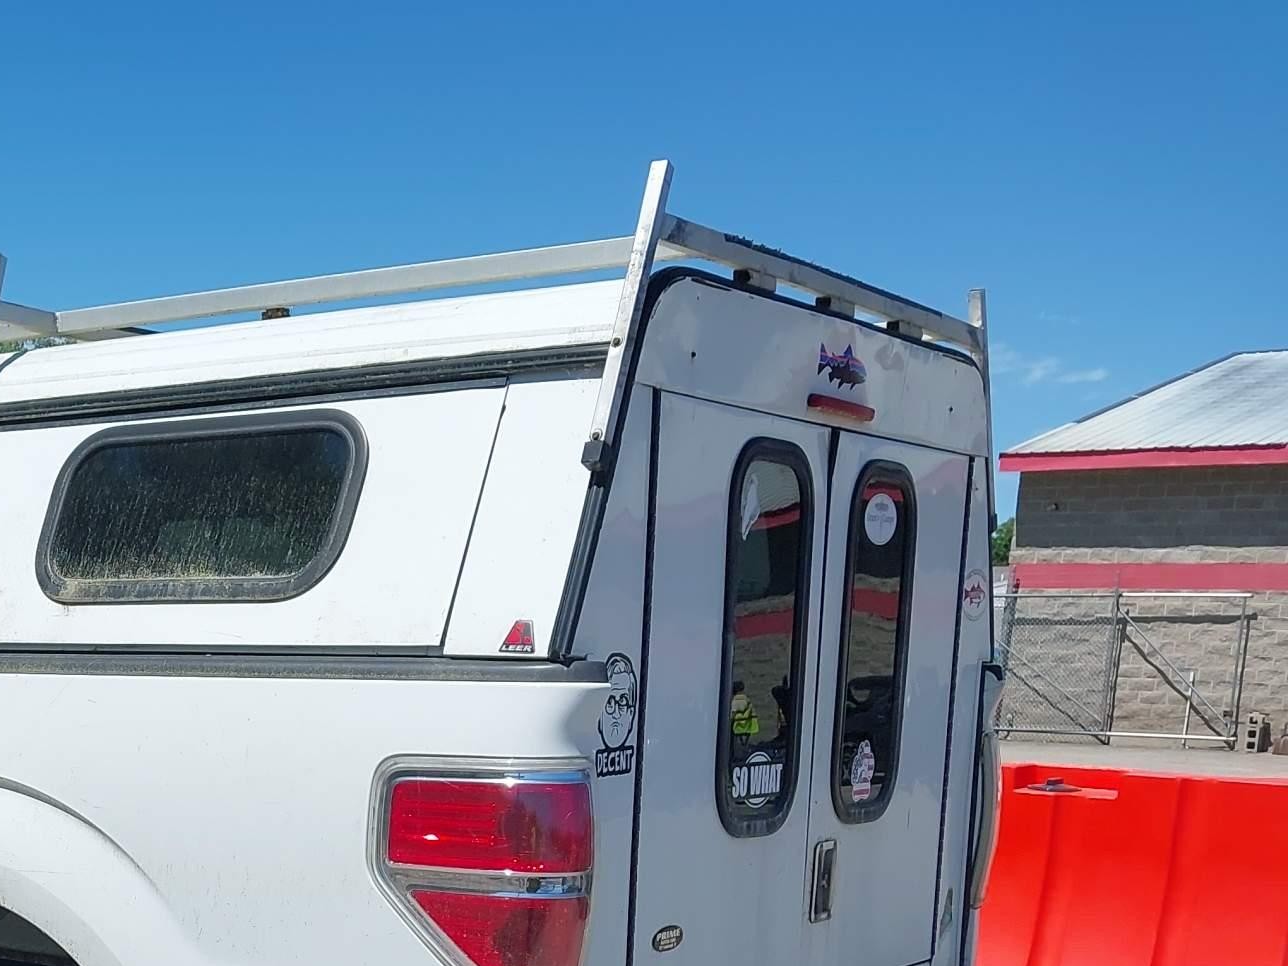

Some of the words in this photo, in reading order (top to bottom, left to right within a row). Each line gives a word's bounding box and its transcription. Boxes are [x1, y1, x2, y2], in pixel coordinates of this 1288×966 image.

[597, 749, 633, 774] DECENT
[732, 766, 749, 798] SO
[750, 763, 784, 796] WHAT
